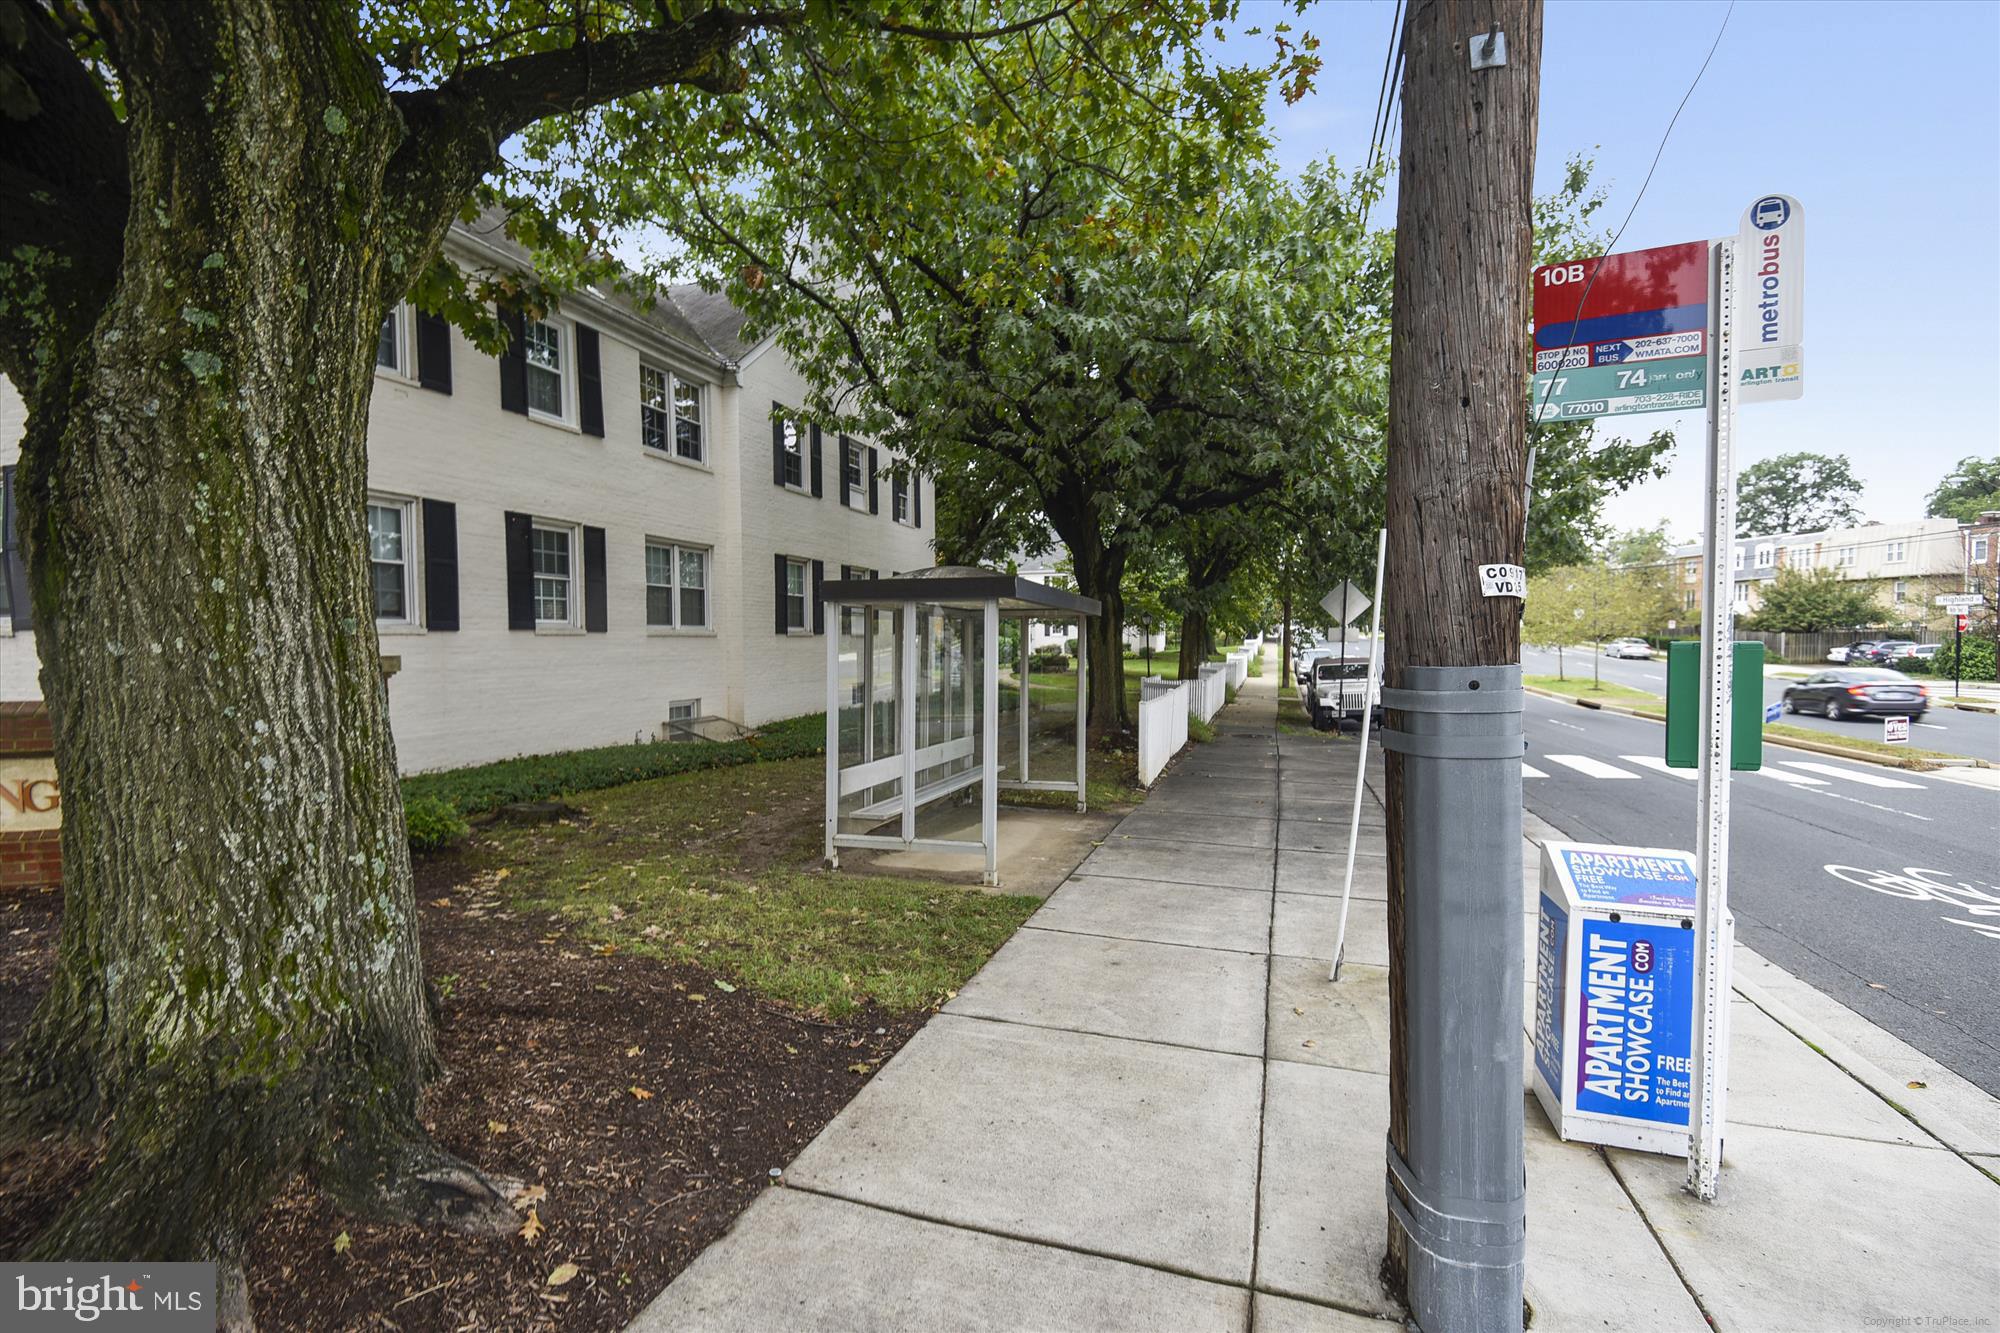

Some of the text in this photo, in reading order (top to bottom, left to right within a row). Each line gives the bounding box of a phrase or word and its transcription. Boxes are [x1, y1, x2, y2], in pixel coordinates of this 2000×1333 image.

[1541, 264, 1584, 287] 10B
[1758, 234, 1780, 342] metrobus
[1596, 343, 1621, 352] NEXT
[1635, 334, 1699, 348] 202-637-7000
[1537, 351, 1559, 360] STOP
[1598, 353, 1618, 362] BUS
[1635, 345, 1699, 357] WMATA.COM
[1537, 357, 1586, 371] 6000200
[1617, 369, 1647, 389] 74
[1741, 366, 1781, 380] ART
[1539, 377, 1567, 397] 77
[1740, 375, 1799, 387] arlington transit
[1634, 390, 1700, 403] 703-228-RIDE
[1567, 402, 1604, 414] 77010
[1615, 399, 1701, 412] arlingtontransit.com
[1943, 595, 1974, 603] Highland
[1570, 852, 1685, 874] APARTMENT
[1575, 874, 1605, 884] FREE
[1535, 905, 1551, 1061] APARTMENT
[1584, 933, 1627, 1100] APARTMENT
[1657, 1055, 1691, 1073] FREE
[1656, 1076, 1688, 1089] The Best
[1656, 1087, 1664, 1095] to
[1665, 1087, 1681, 1097] Find
